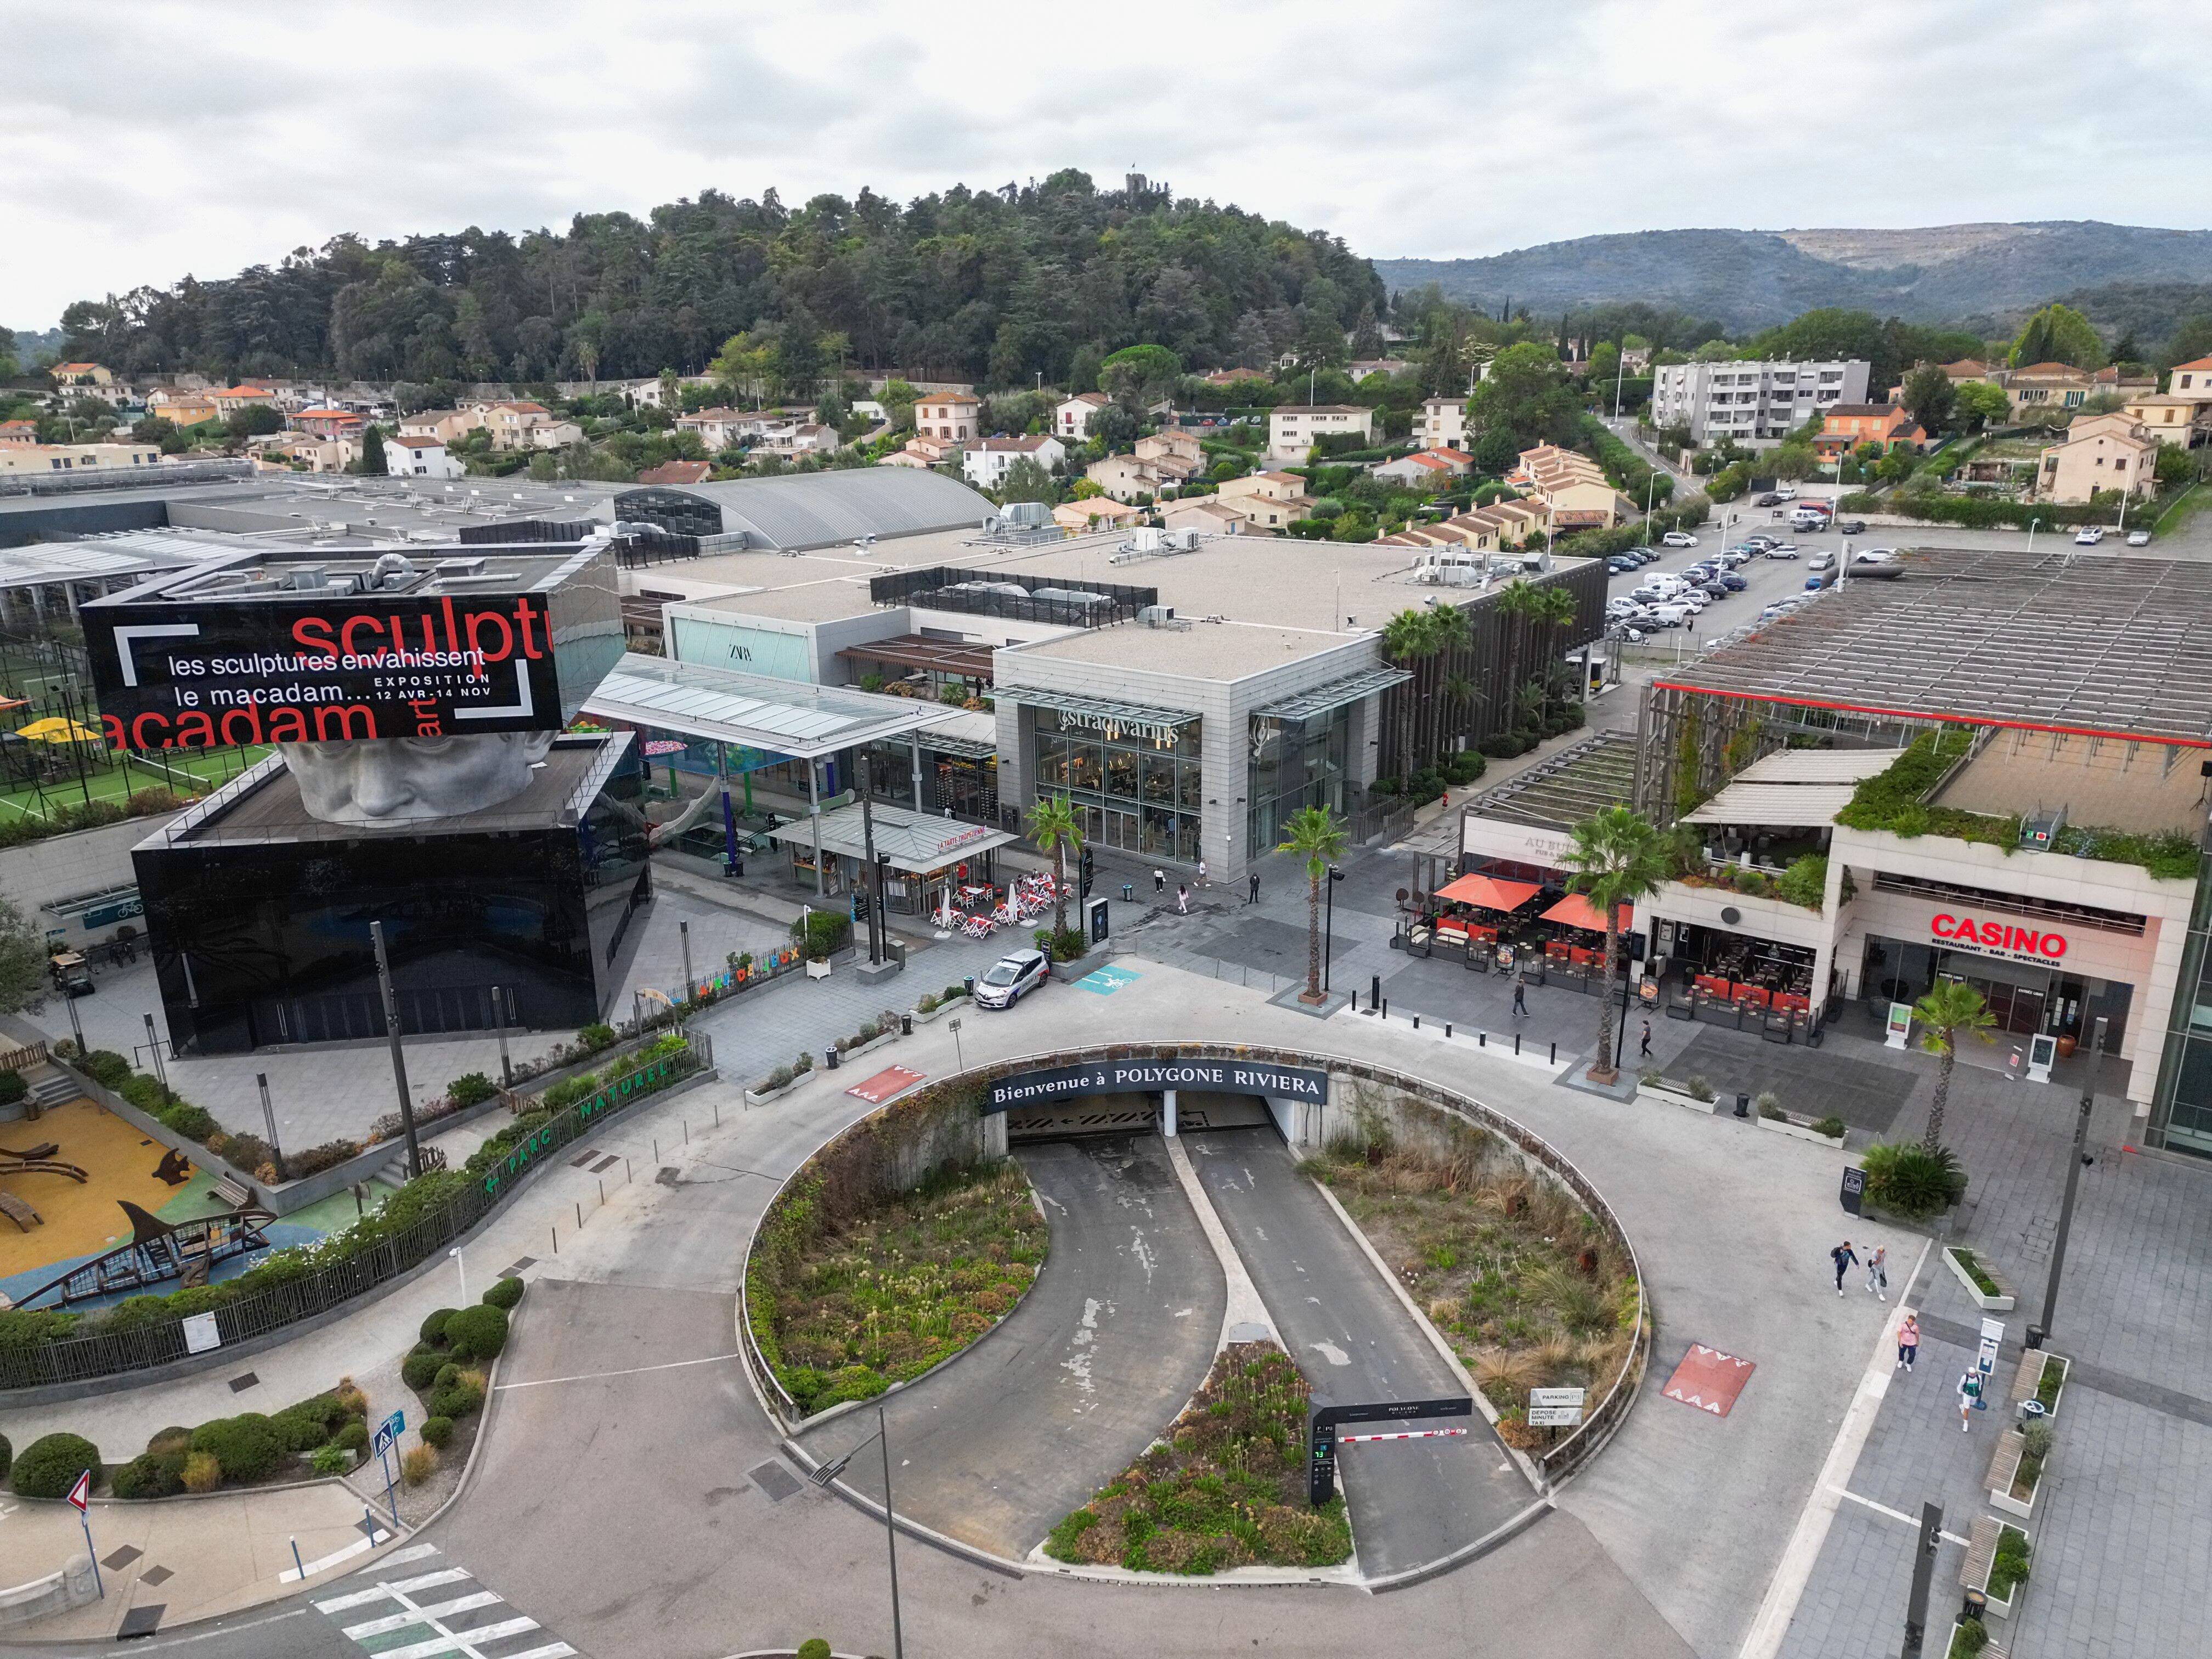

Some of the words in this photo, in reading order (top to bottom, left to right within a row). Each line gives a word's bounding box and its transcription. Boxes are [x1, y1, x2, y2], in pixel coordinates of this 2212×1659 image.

[292, 596, 554, 679] sculpt
[168, 656, 205, 675] les
[211, 653, 337, 678] sculptures
[342, 647, 486, 670] envahissent
[729, 644, 752, 662] ZARA
[374, 674, 489, 687] EXPOSITION
[376, 691, 392, 700] 12
[461, 687, 490, 697] NOV
[174, 686, 199, 707] le
[1525, 837, 1544, 849] AU
[1932, 914, 2067, 958] CASINO
[1932, 938, 1982, 952] RESTAURANT
[2013, 953, 2061, 967] SPECTACLES
[994, 1077, 1090, 1103] Bienvenue
[1096, 1072, 1105, 1085] à
[1114, 1068, 1223, 1084] POLYGONE
[1234, 1070, 1319, 1095] RIVIERA
[509, 1129, 550, 1174] PARC
[580, 1063, 667, 1119] NATUREL
